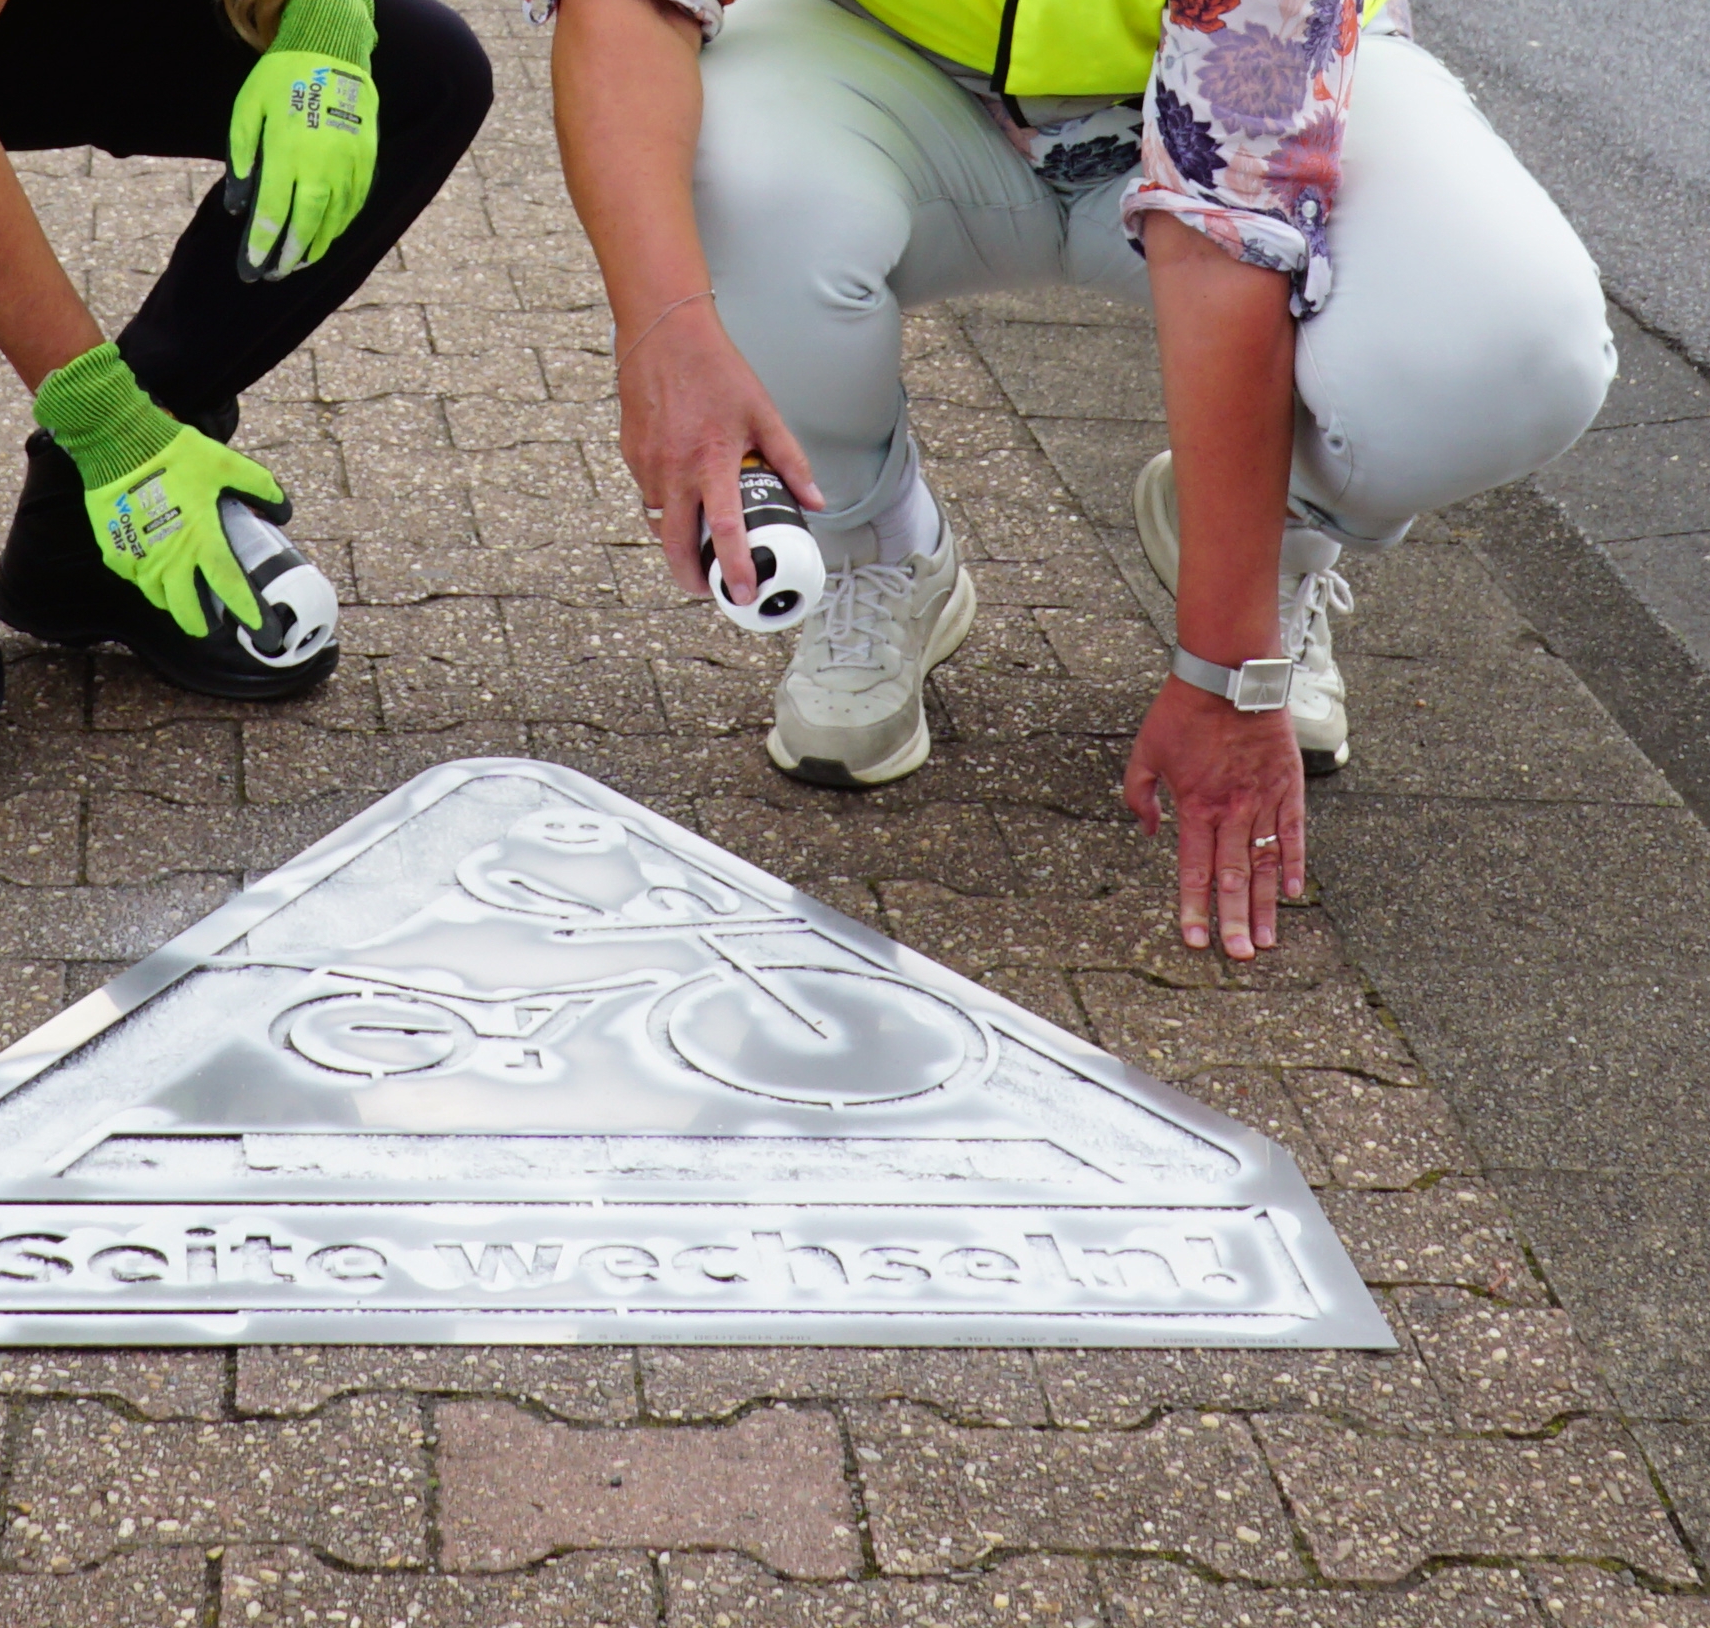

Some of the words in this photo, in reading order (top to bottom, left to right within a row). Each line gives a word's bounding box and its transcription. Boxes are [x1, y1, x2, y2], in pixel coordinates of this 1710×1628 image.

[291, 80, 307, 112] GRIP
[307, 67, 331, 130] WONDER
[107, 518, 127, 553] GRIP
[114, 492, 148, 561] WONDER
[433, 1228, 1239, 1290] wechseln!
